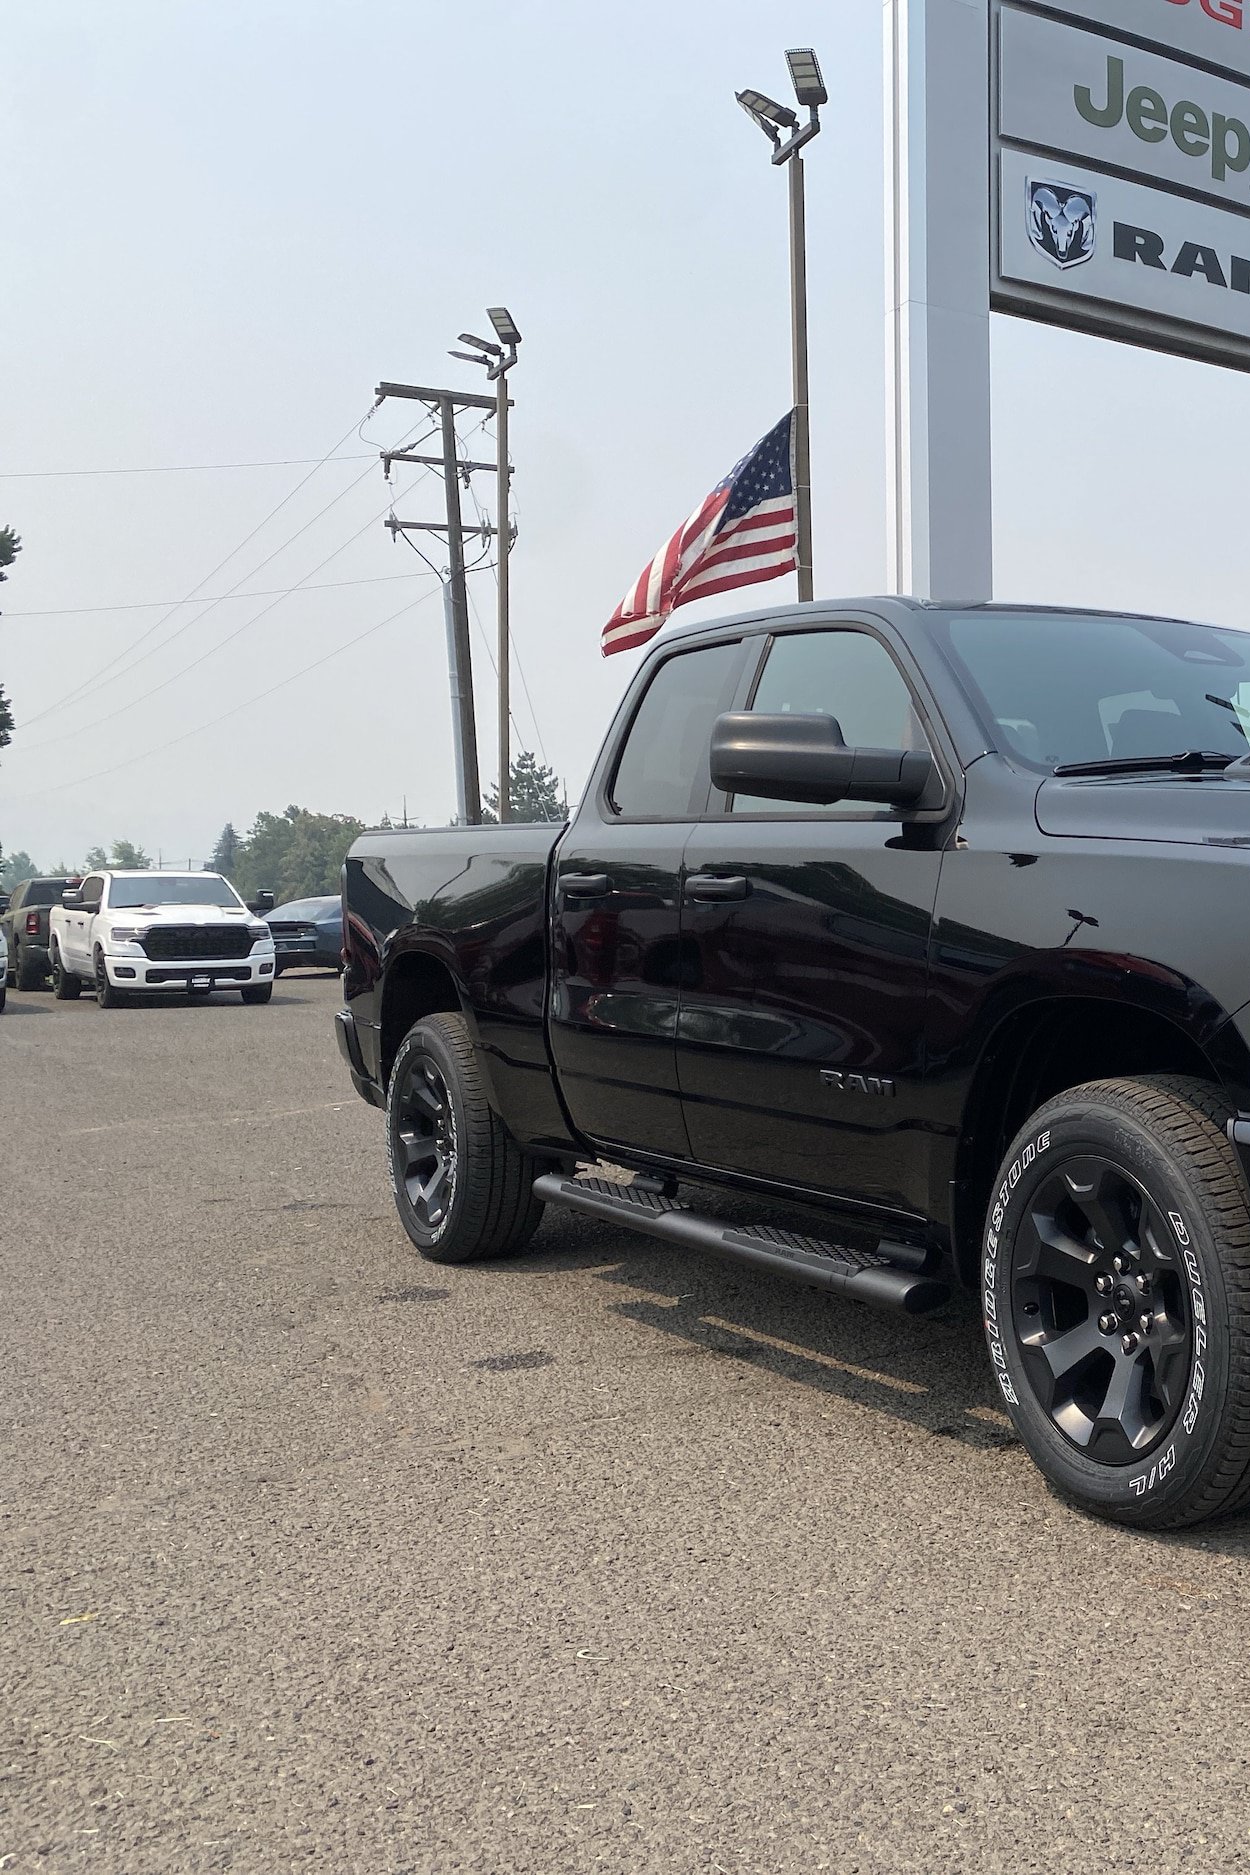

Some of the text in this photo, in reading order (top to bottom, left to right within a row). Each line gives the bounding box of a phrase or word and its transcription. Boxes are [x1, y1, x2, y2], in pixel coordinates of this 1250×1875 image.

[820, 1069, 895, 1097] RAM
[982, 1130, 1051, 1406] BRIDGESTONE
[1168, 1211, 1208, 1435] DUELER
